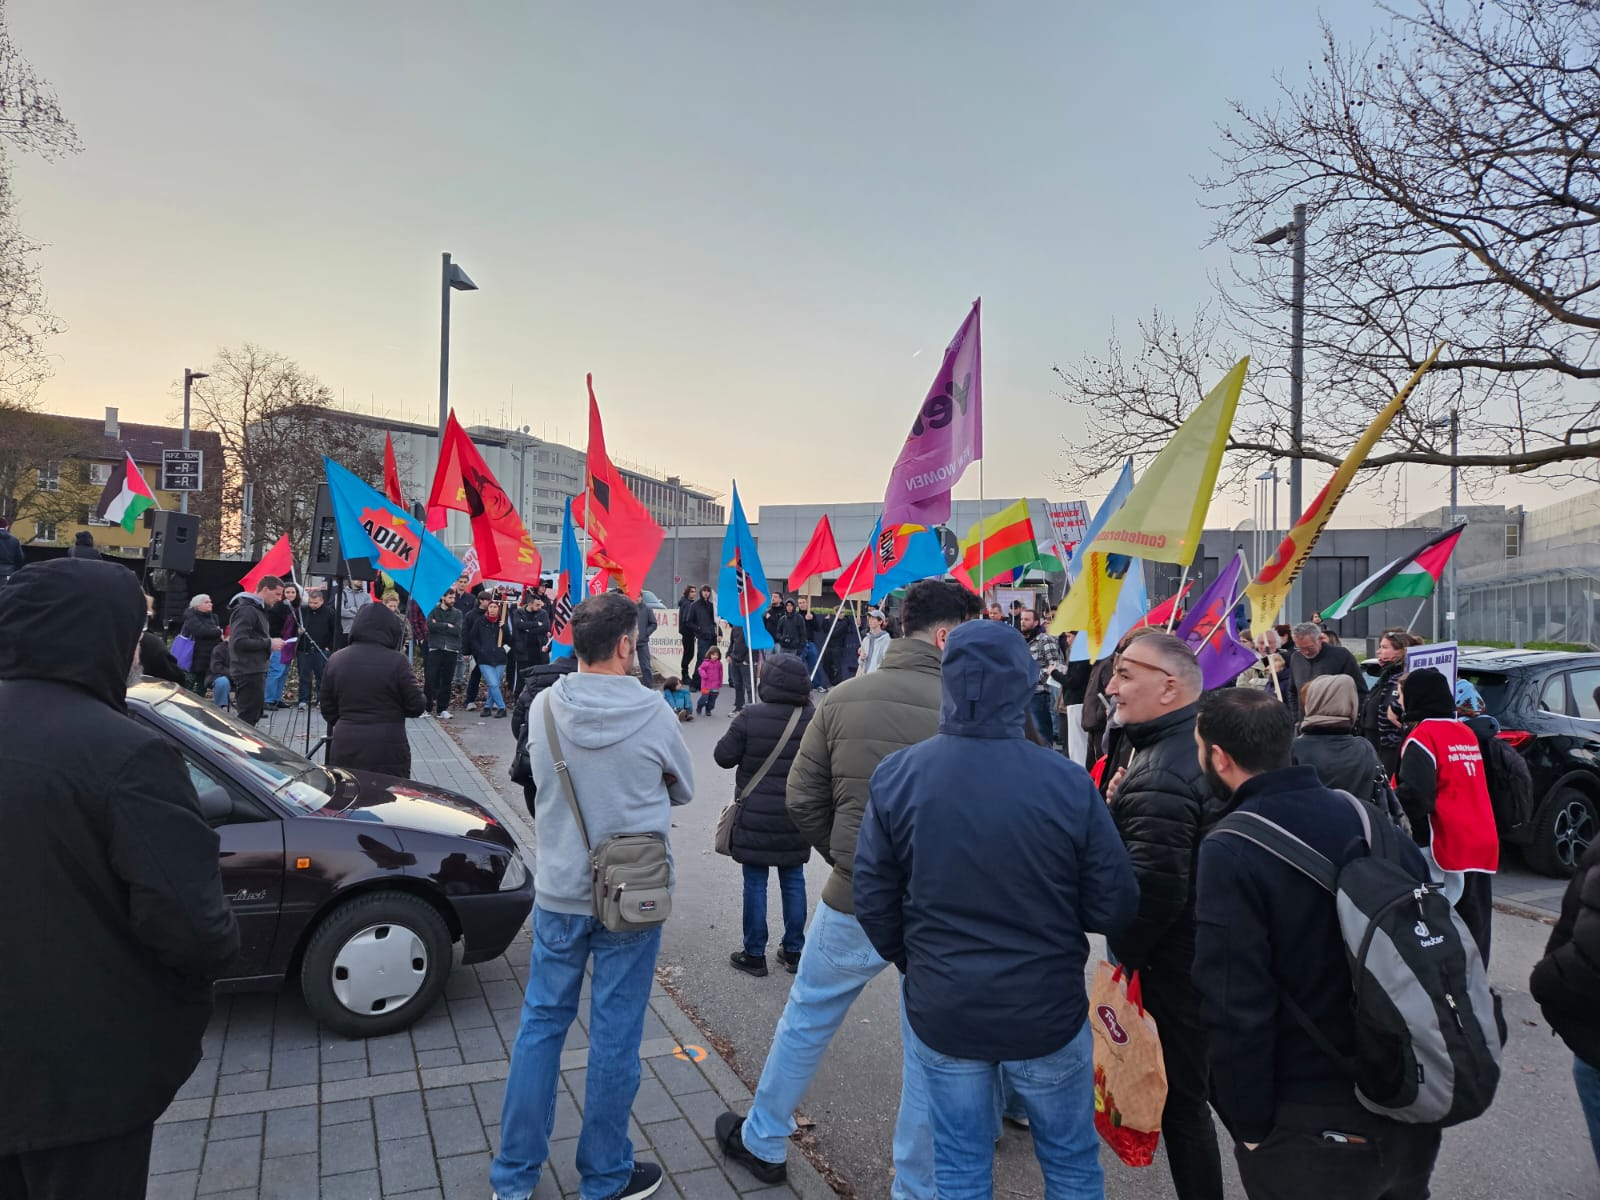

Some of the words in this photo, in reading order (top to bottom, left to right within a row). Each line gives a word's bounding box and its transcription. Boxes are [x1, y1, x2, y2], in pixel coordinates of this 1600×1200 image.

[362, 519, 414, 562] ADHK
[880, 529, 896, 568] ADHK
[1435, 653, 1453, 665] MÄRZ
